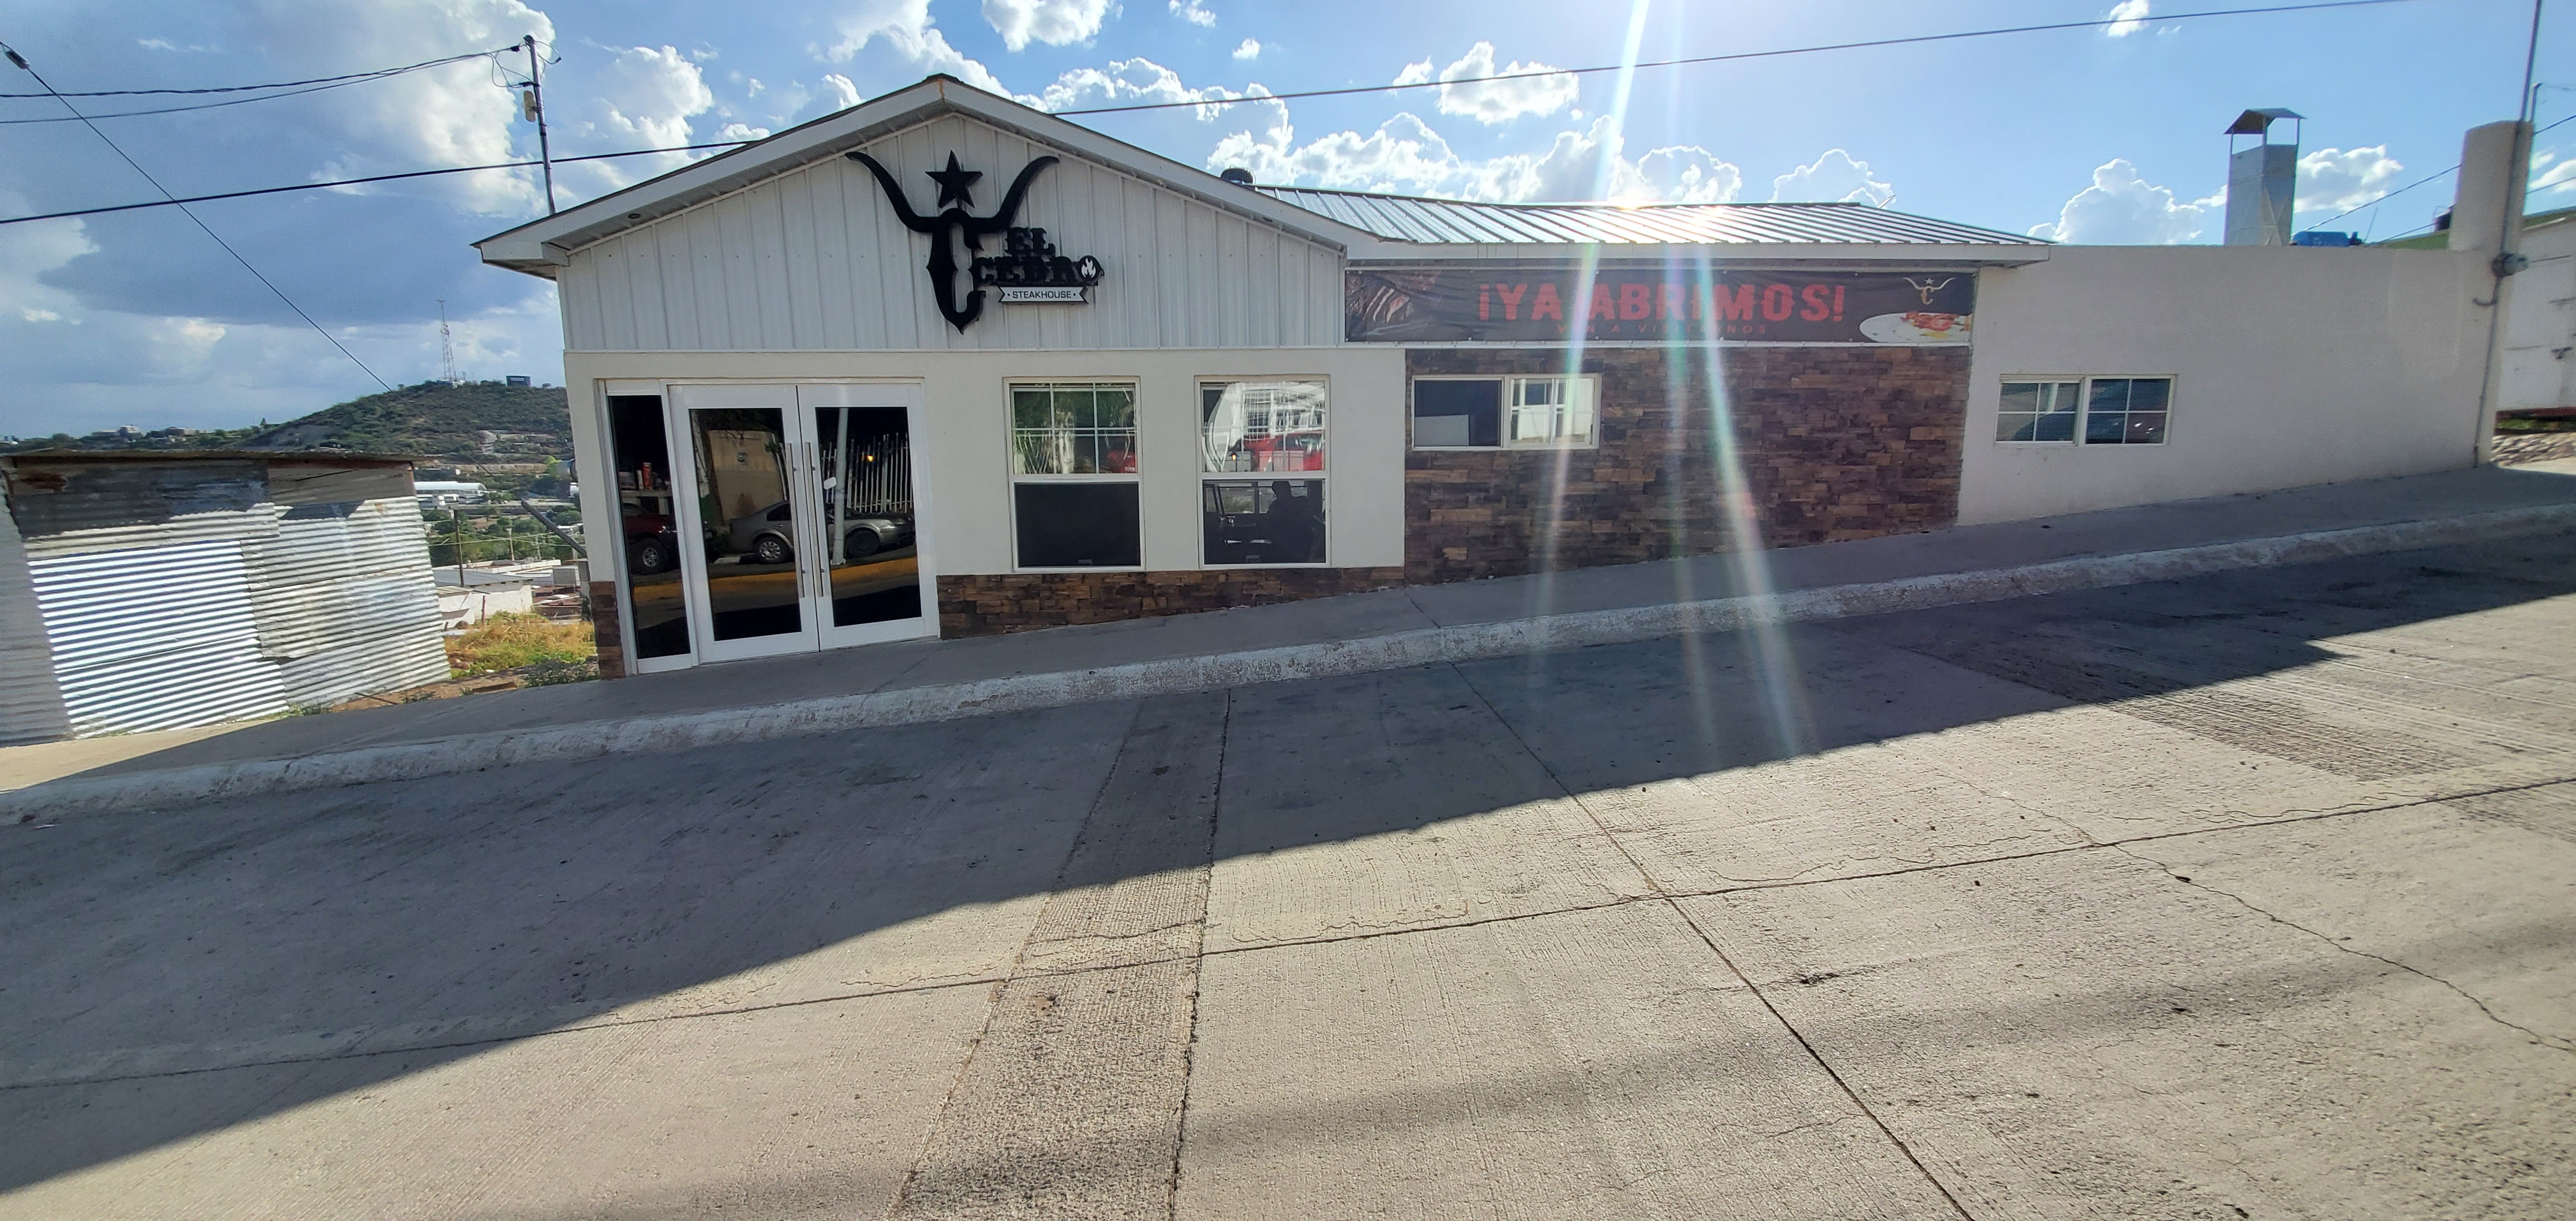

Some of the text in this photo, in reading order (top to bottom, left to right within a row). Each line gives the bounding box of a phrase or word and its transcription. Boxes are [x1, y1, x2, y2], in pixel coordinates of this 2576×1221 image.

[1012, 290, 1072, 299] STEAKHOUSE
[1585, 283, 1844, 322] ABRIMOS!
[1557, 325, 1595, 334] VN
